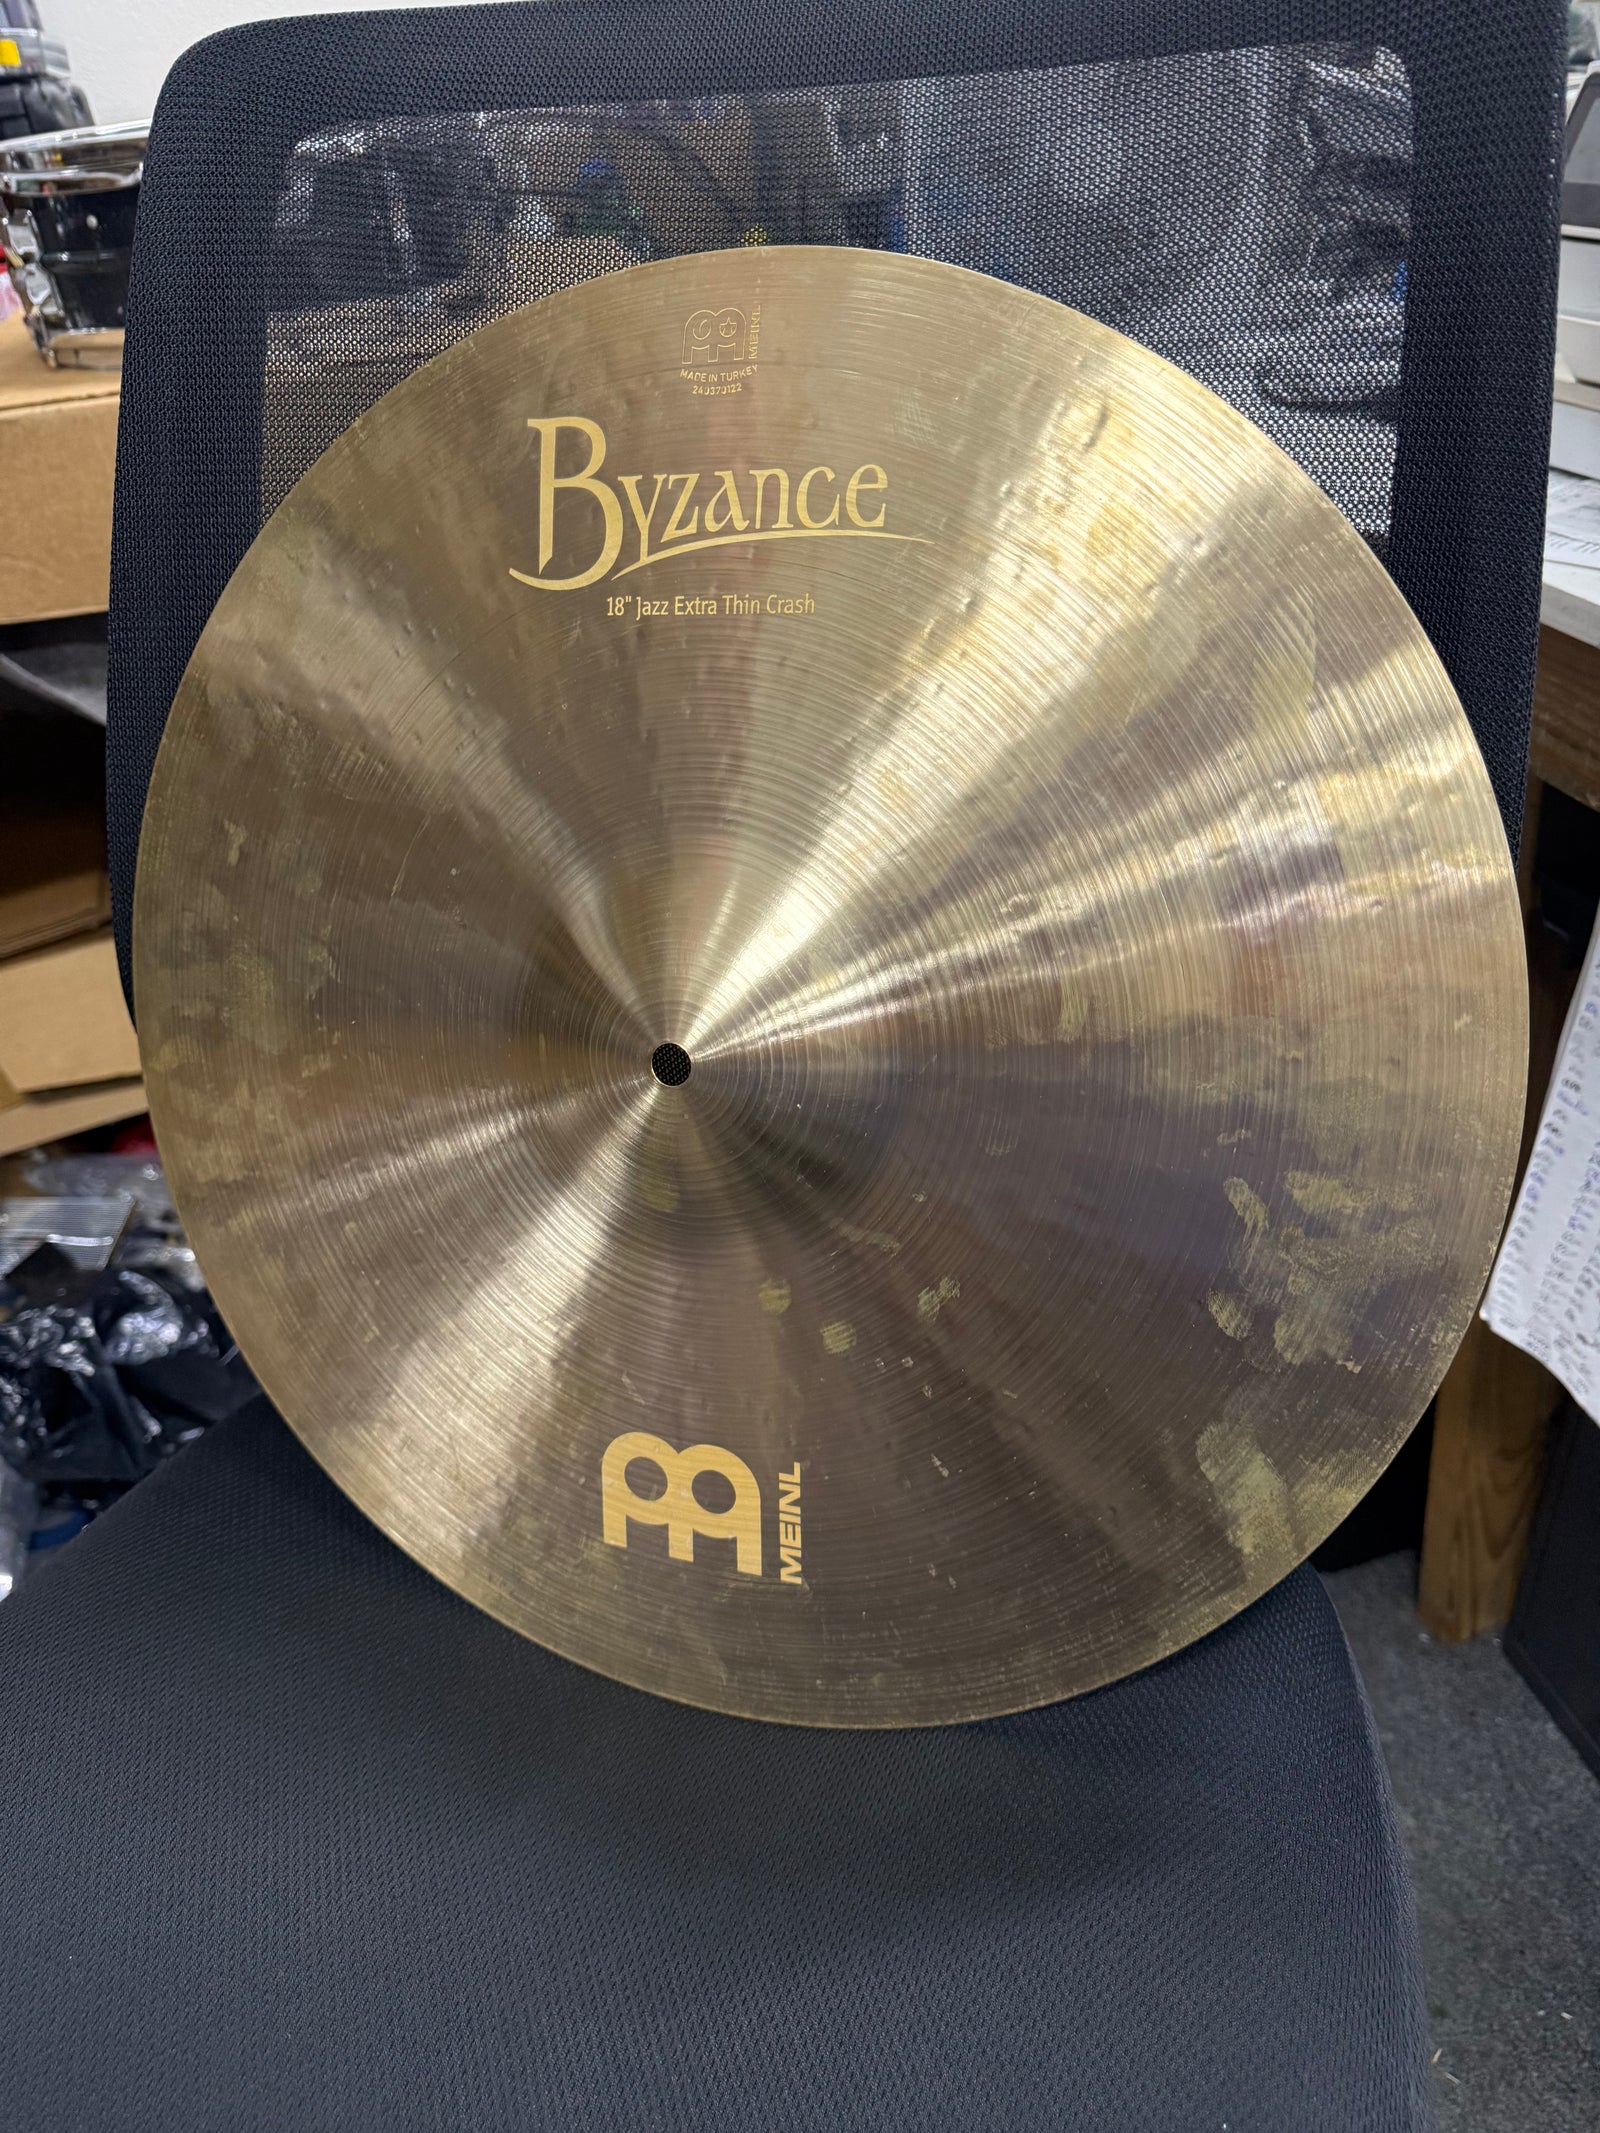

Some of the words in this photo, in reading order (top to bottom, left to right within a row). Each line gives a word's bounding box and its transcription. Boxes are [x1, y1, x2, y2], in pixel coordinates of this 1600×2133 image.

[748, 305, 760, 359] MEINL
[680, 368, 707, 382] MADE
[708, 373, 719, 382] IN
[720, 364, 758, 382] TURKEY
[509, 416, 888, 591] Byzance
[607, 596, 632, 616] 18"
[635, 597, 669, 621] Jazz
[674, 596, 718, 616] Extra
[722, 593, 760, 615] Thin
[766, 593, 815, 614] Crash
[779, 1462, 802, 1584] MEINL
